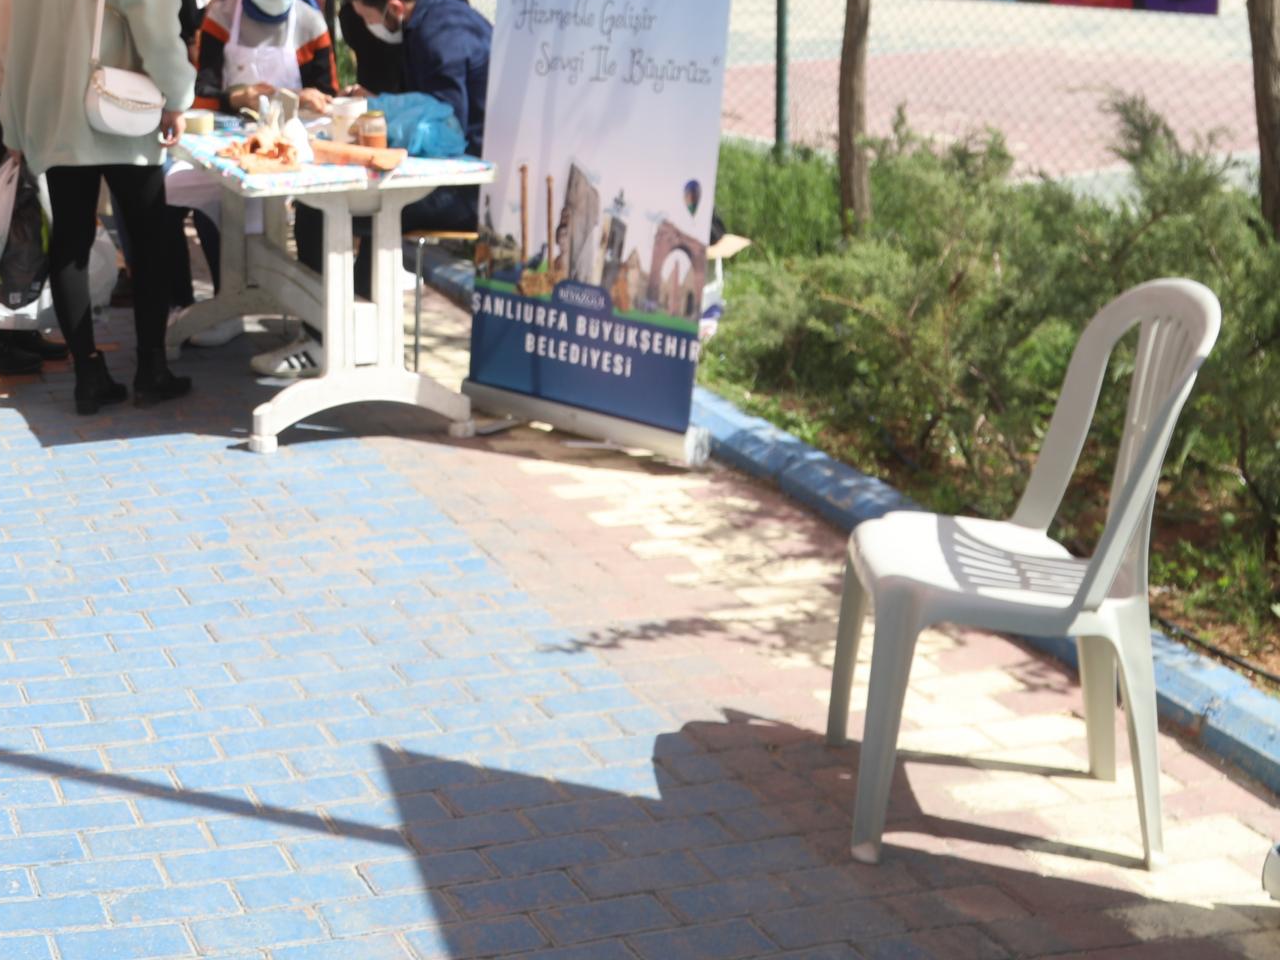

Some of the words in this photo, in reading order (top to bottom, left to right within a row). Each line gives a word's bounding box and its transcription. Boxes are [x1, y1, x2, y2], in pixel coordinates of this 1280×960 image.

[535, 41, 584, 85] Sevgi
[472, 292, 568, 332] ŞANLIURFA
[575, 316, 700, 362] BÜYÜKŞEHİR
[524, 333, 632, 378] BELEDİYESİ
